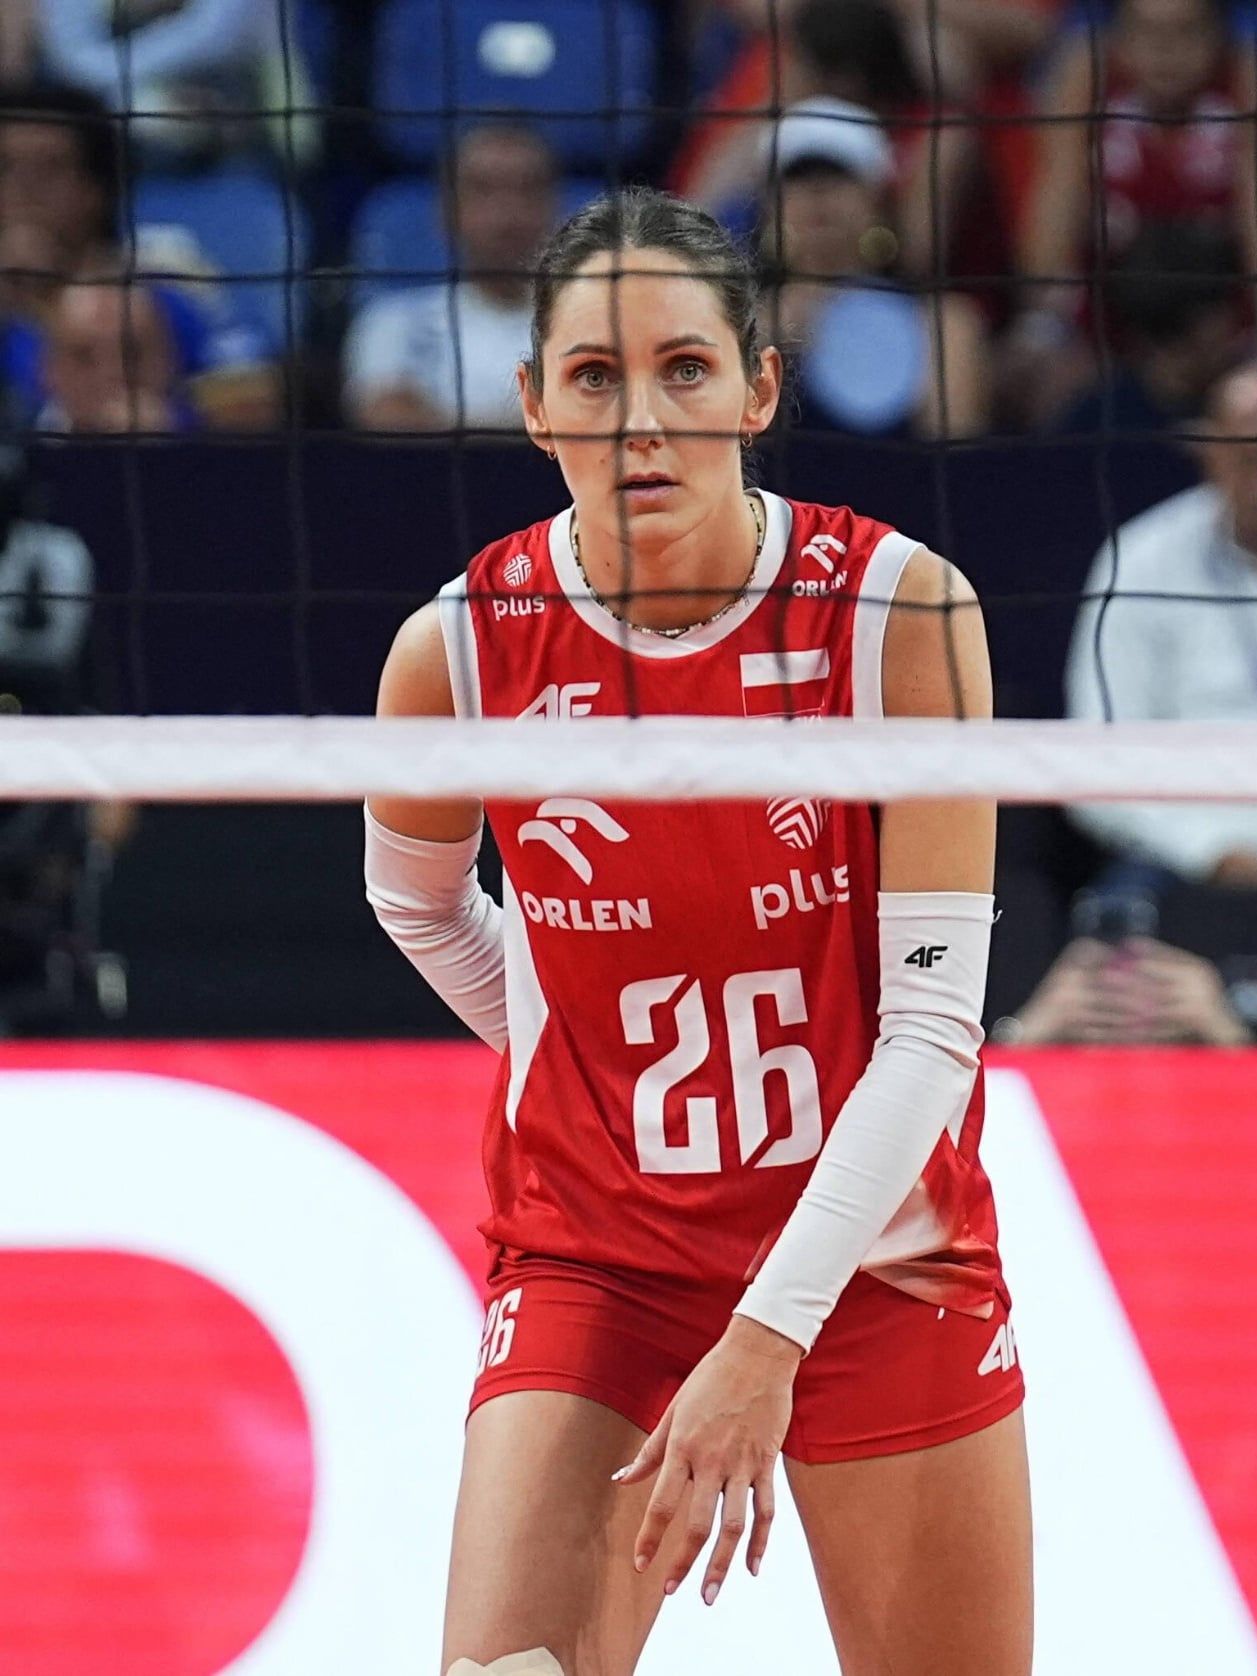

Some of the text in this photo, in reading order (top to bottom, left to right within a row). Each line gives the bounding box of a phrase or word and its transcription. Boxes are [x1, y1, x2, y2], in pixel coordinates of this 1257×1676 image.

[492, 595, 546, 621] plus
[522, 891, 652, 932] ORLEN
[750, 864, 850, 930] plus
[904, 945, 948, 968] 4F
[619, 967, 823, 1175] 26
